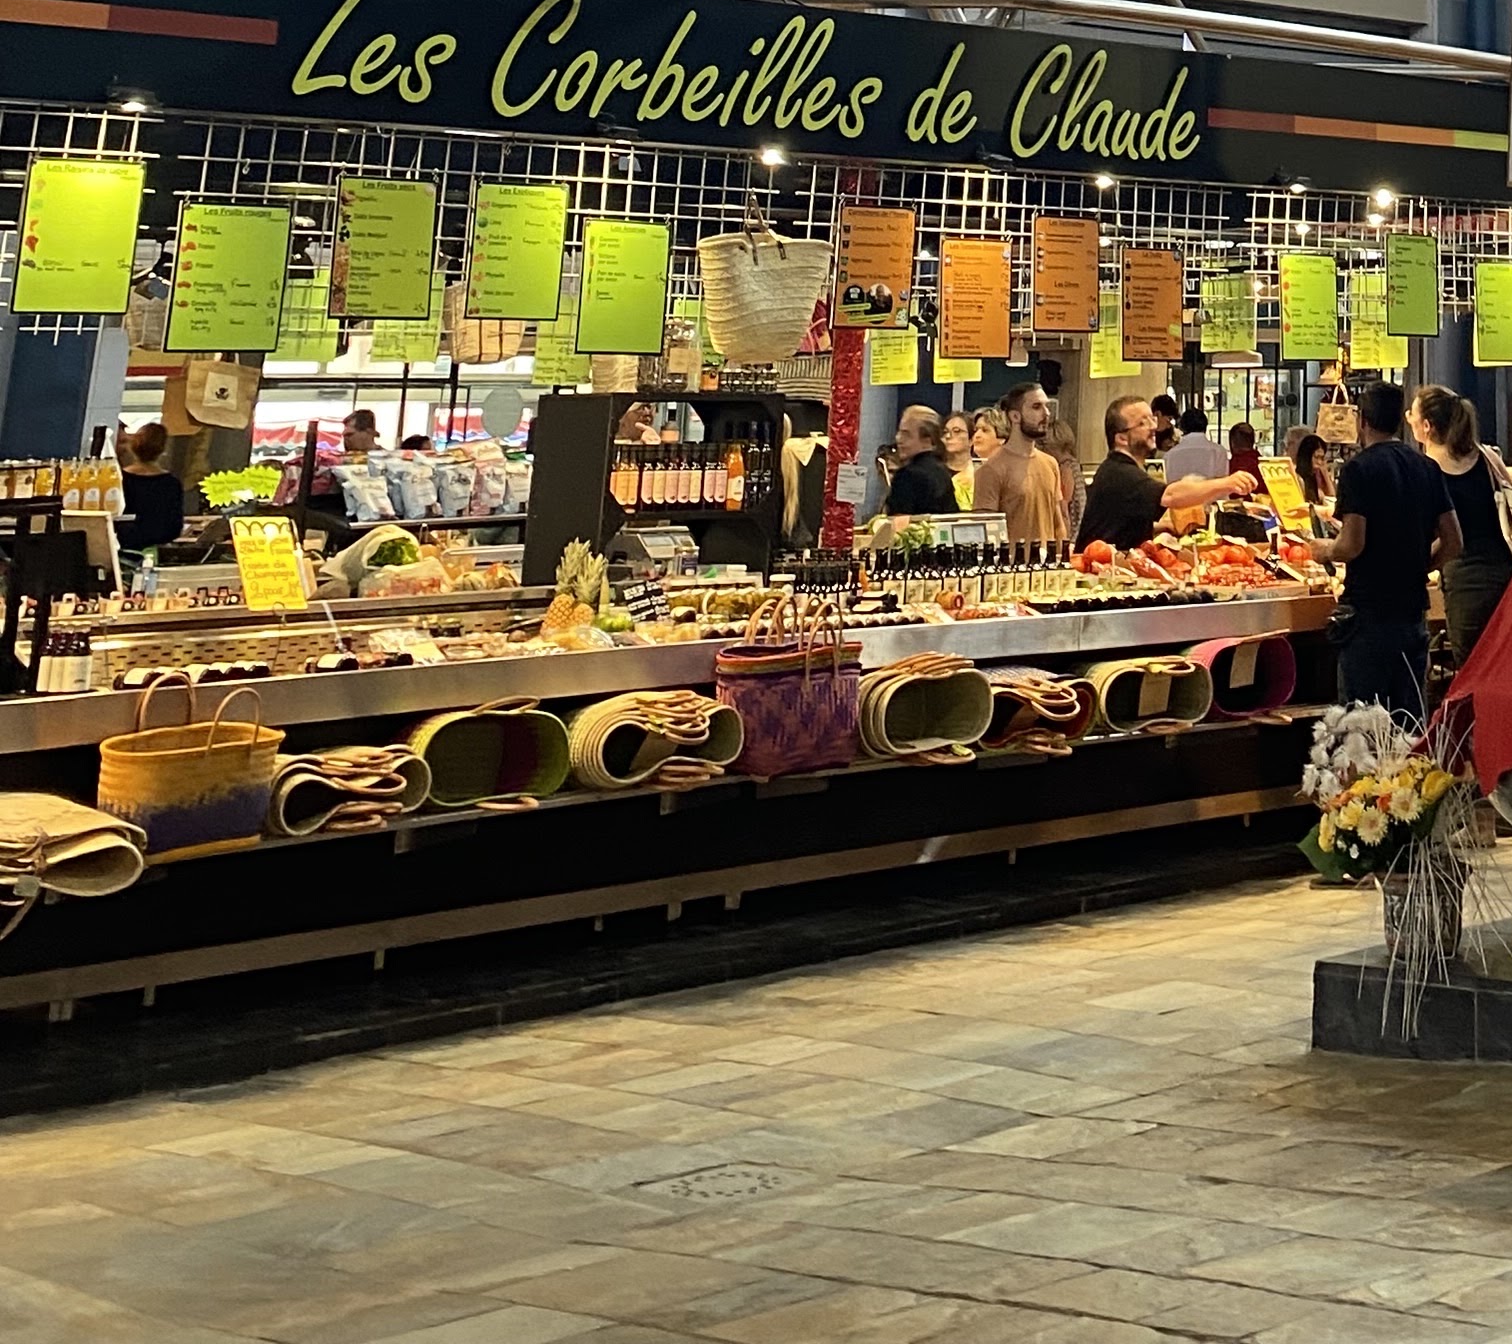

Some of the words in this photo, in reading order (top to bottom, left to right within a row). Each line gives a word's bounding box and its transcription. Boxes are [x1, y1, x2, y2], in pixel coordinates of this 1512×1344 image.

[905, 42, 977, 144] de
[1009, 43, 1200, 161] Claude
[219, 208, 243, 217] Fruits
